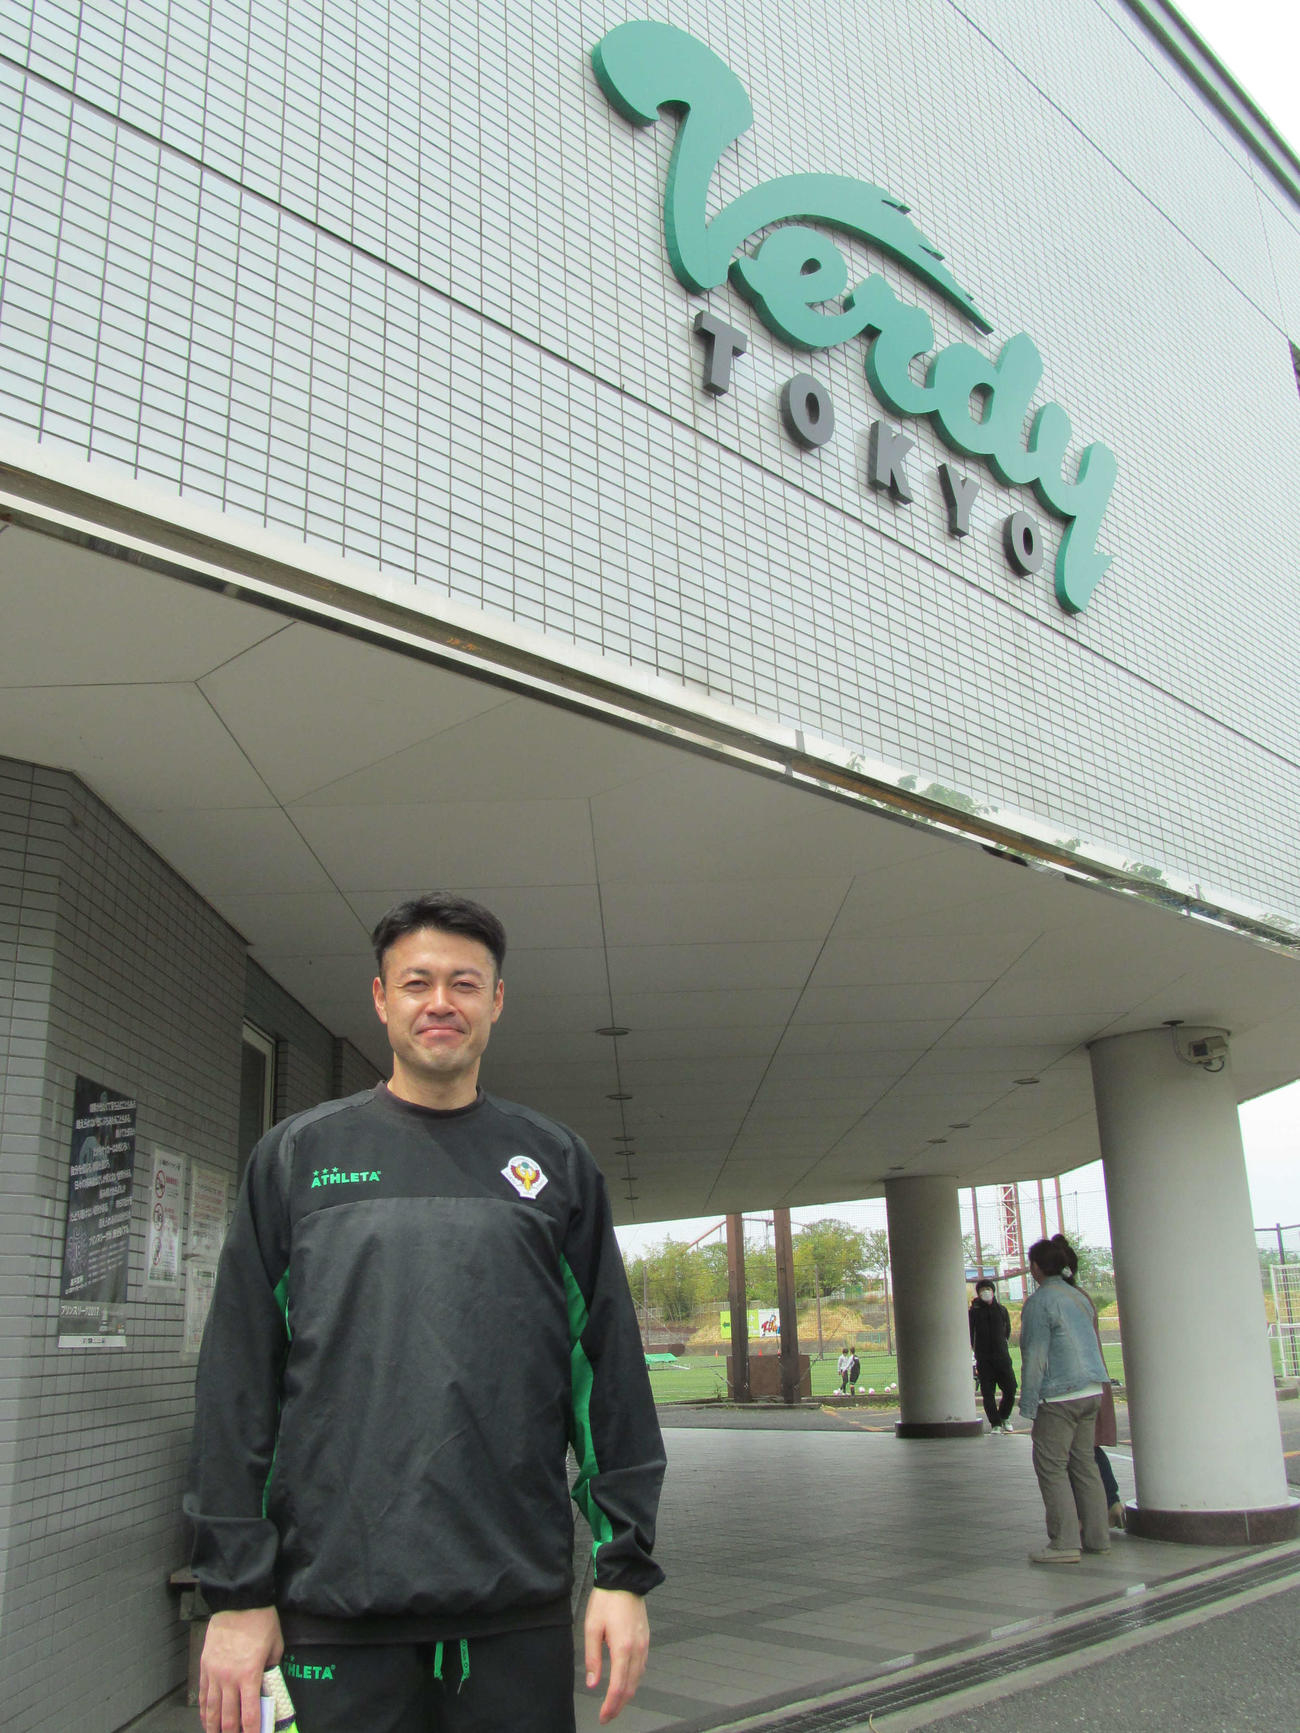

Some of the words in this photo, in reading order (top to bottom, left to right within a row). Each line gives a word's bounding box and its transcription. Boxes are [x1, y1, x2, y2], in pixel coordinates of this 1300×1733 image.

[591, 20, 1117, 615] Verdy
[694, 310, 1044, 577] TOKYO
[311, 1171, 380, 1188] ATHLETA
[284, 1662, 334, 1680] HLETA
